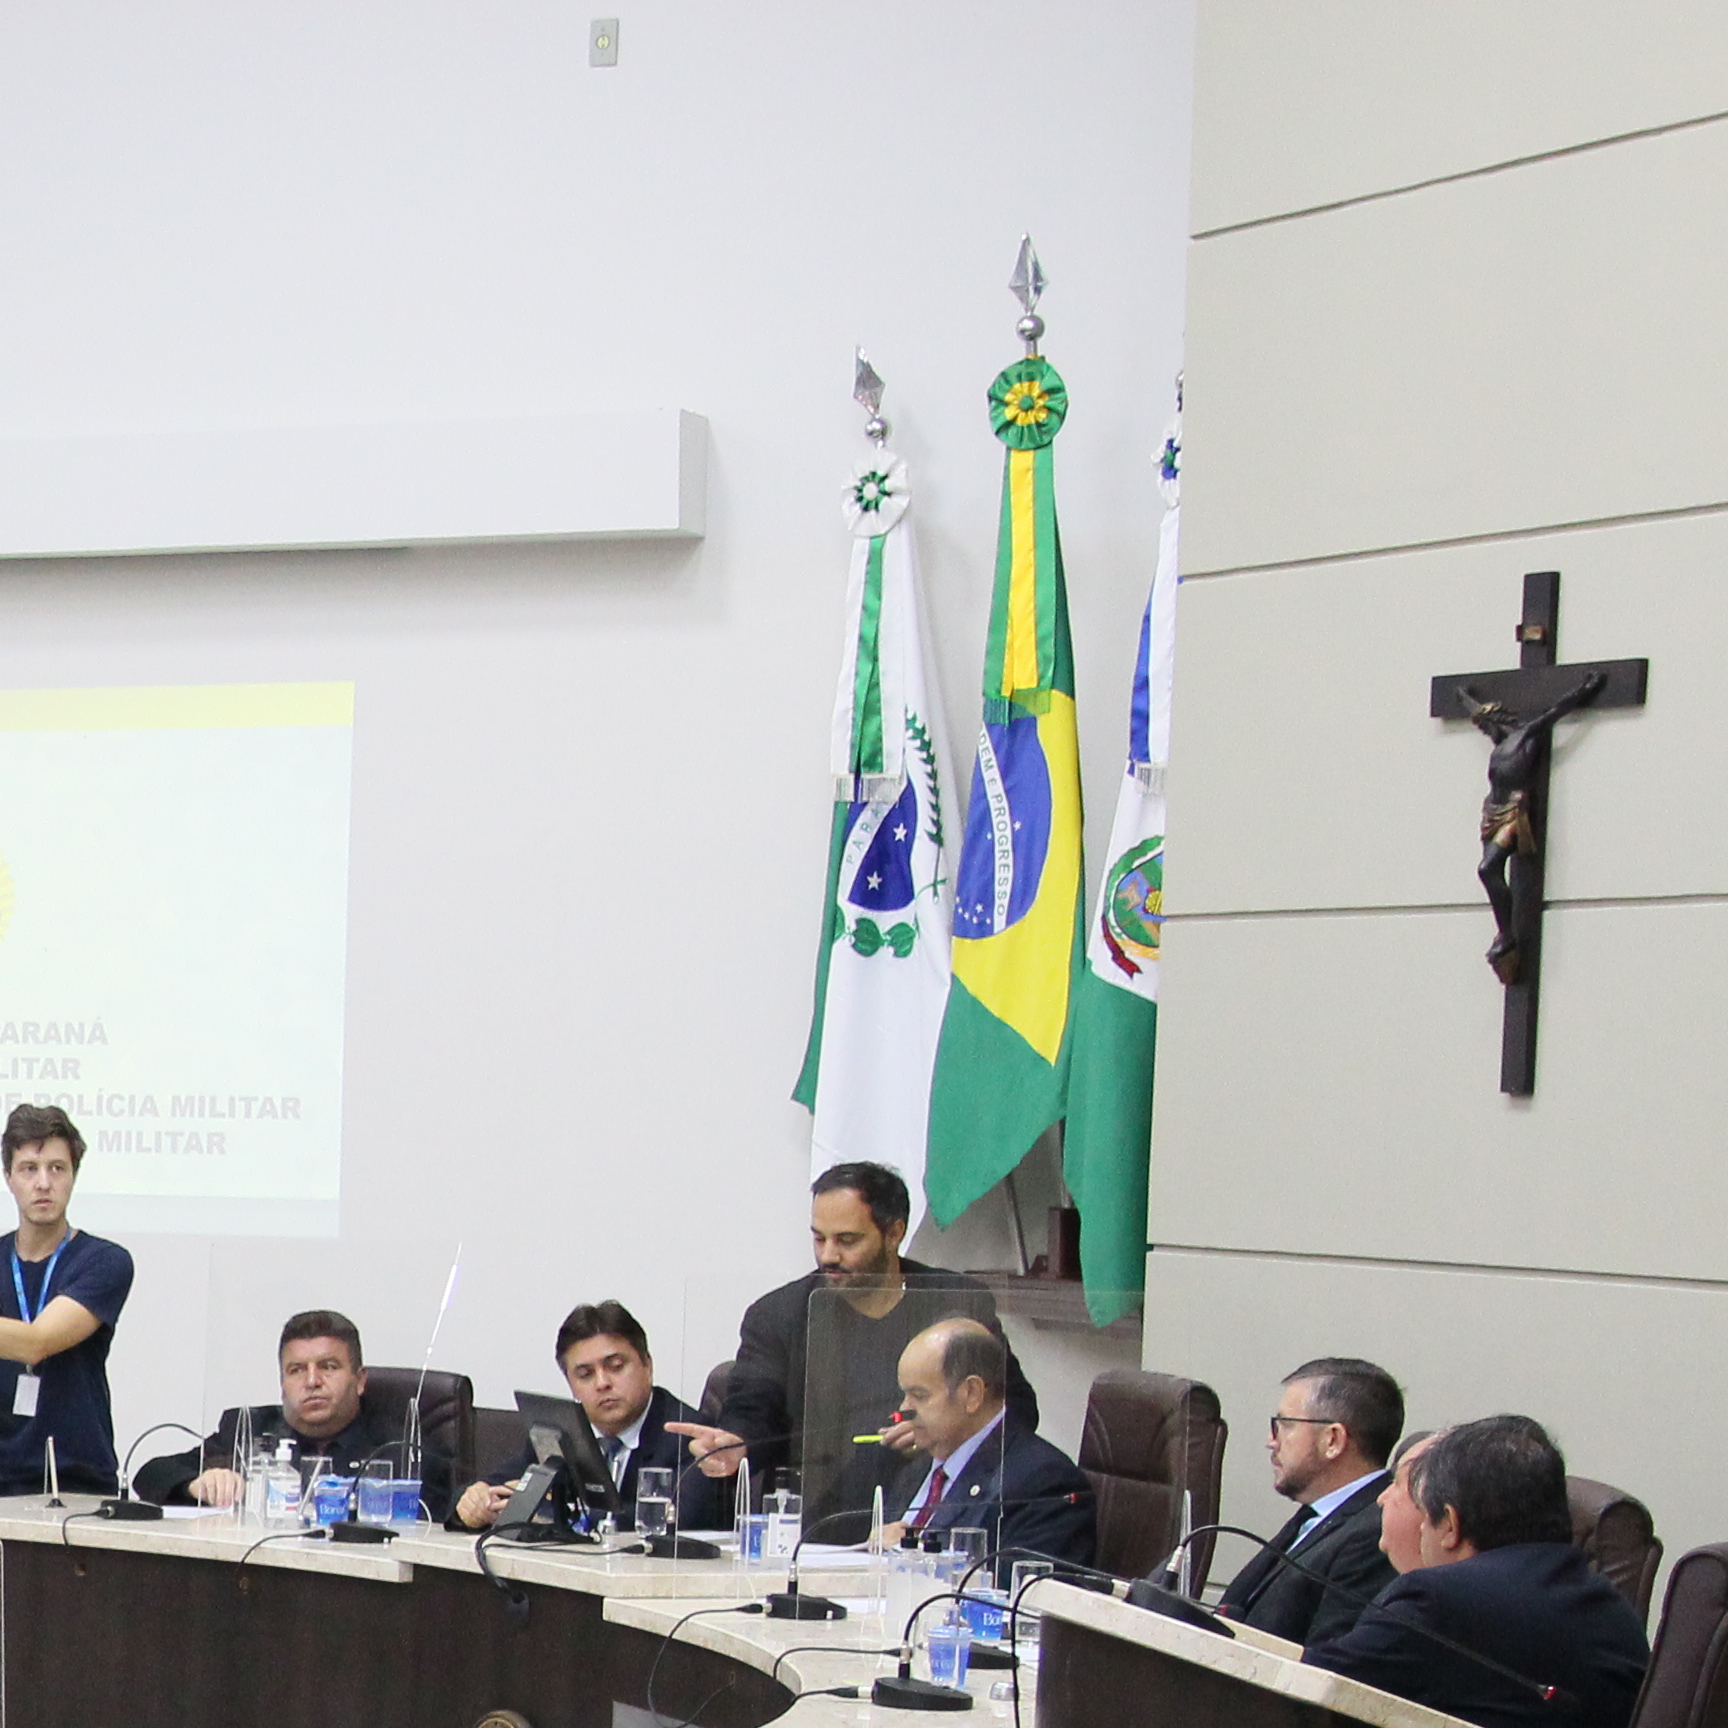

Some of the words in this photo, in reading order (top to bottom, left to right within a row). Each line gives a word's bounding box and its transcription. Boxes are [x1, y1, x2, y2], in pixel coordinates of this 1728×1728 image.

[979, 731, 994, 773] DEM
[993, 793, 1011, 917] PROGRESSO
[171, 1095, 302, 1120] MILITAR
[98, 1130, 227, 1156] MILITAR
